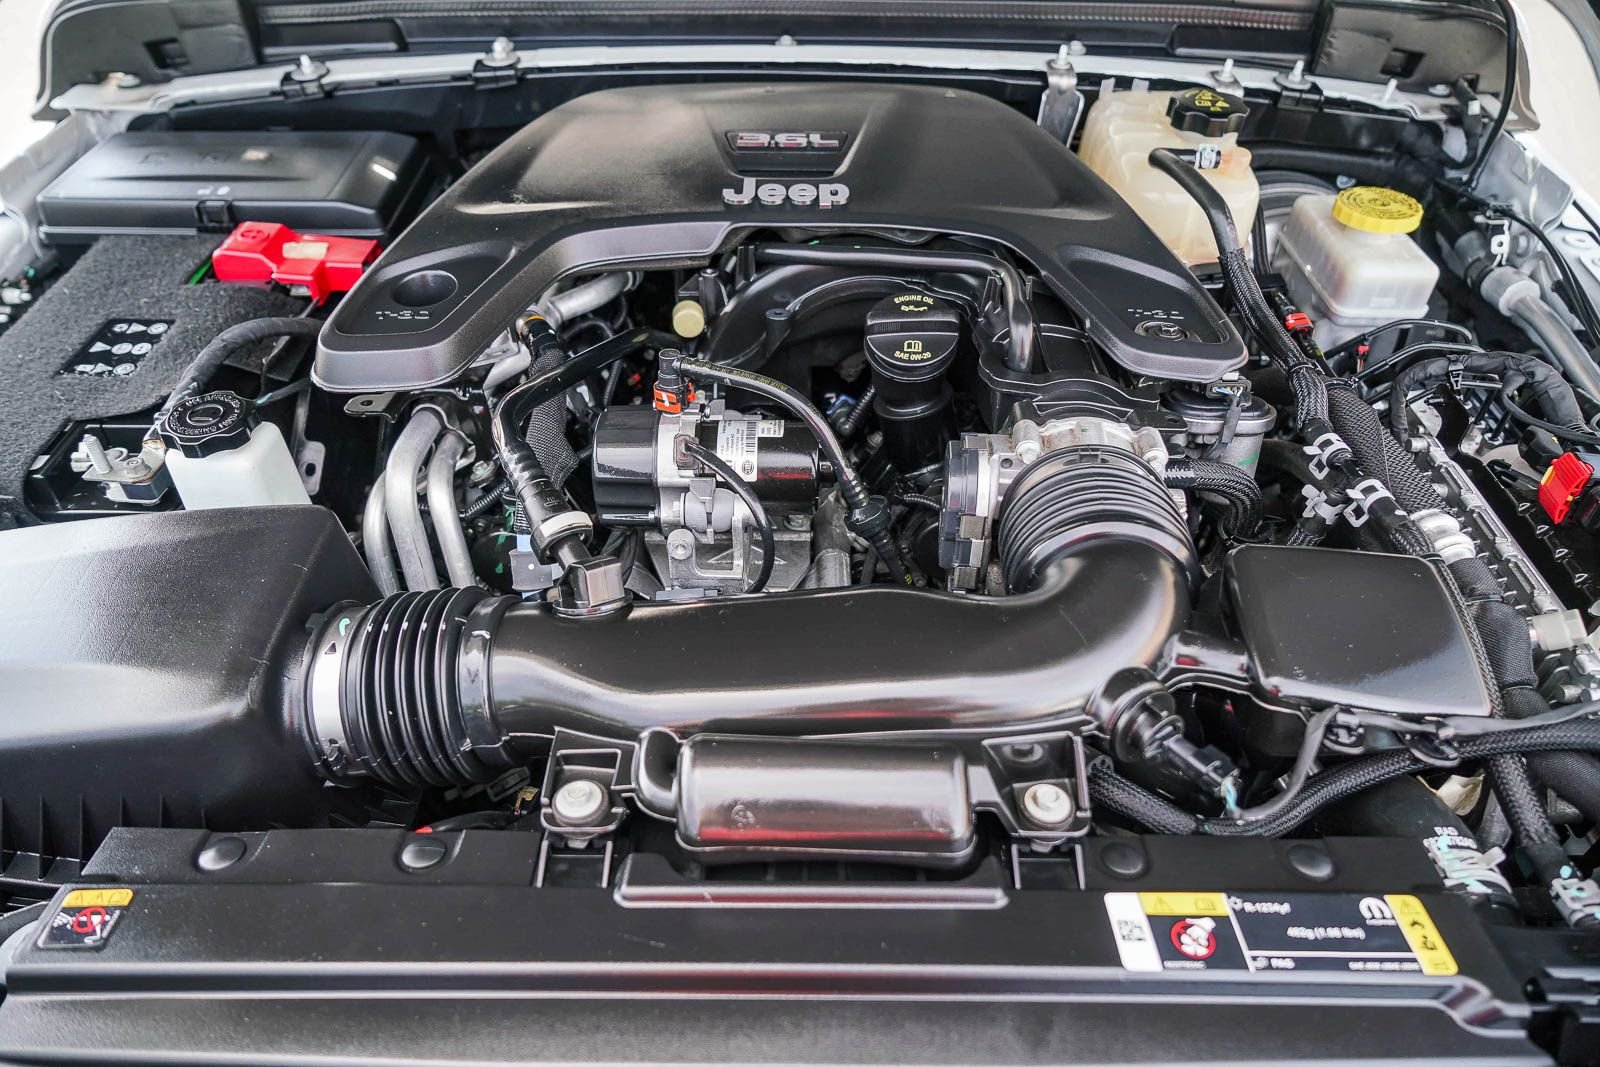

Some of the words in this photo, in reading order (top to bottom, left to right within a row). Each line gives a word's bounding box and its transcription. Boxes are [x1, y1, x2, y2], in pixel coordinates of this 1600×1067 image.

[736, 132, 839, 148] 3.6L
[722, 178, 850, 209] Jeep
[893, 295, 922, 304] ENGINE
[922, 296, 934, 305] OIL
[894, 350, 909, 360] SAE
[909, 351, 932, 361] 0W-20
